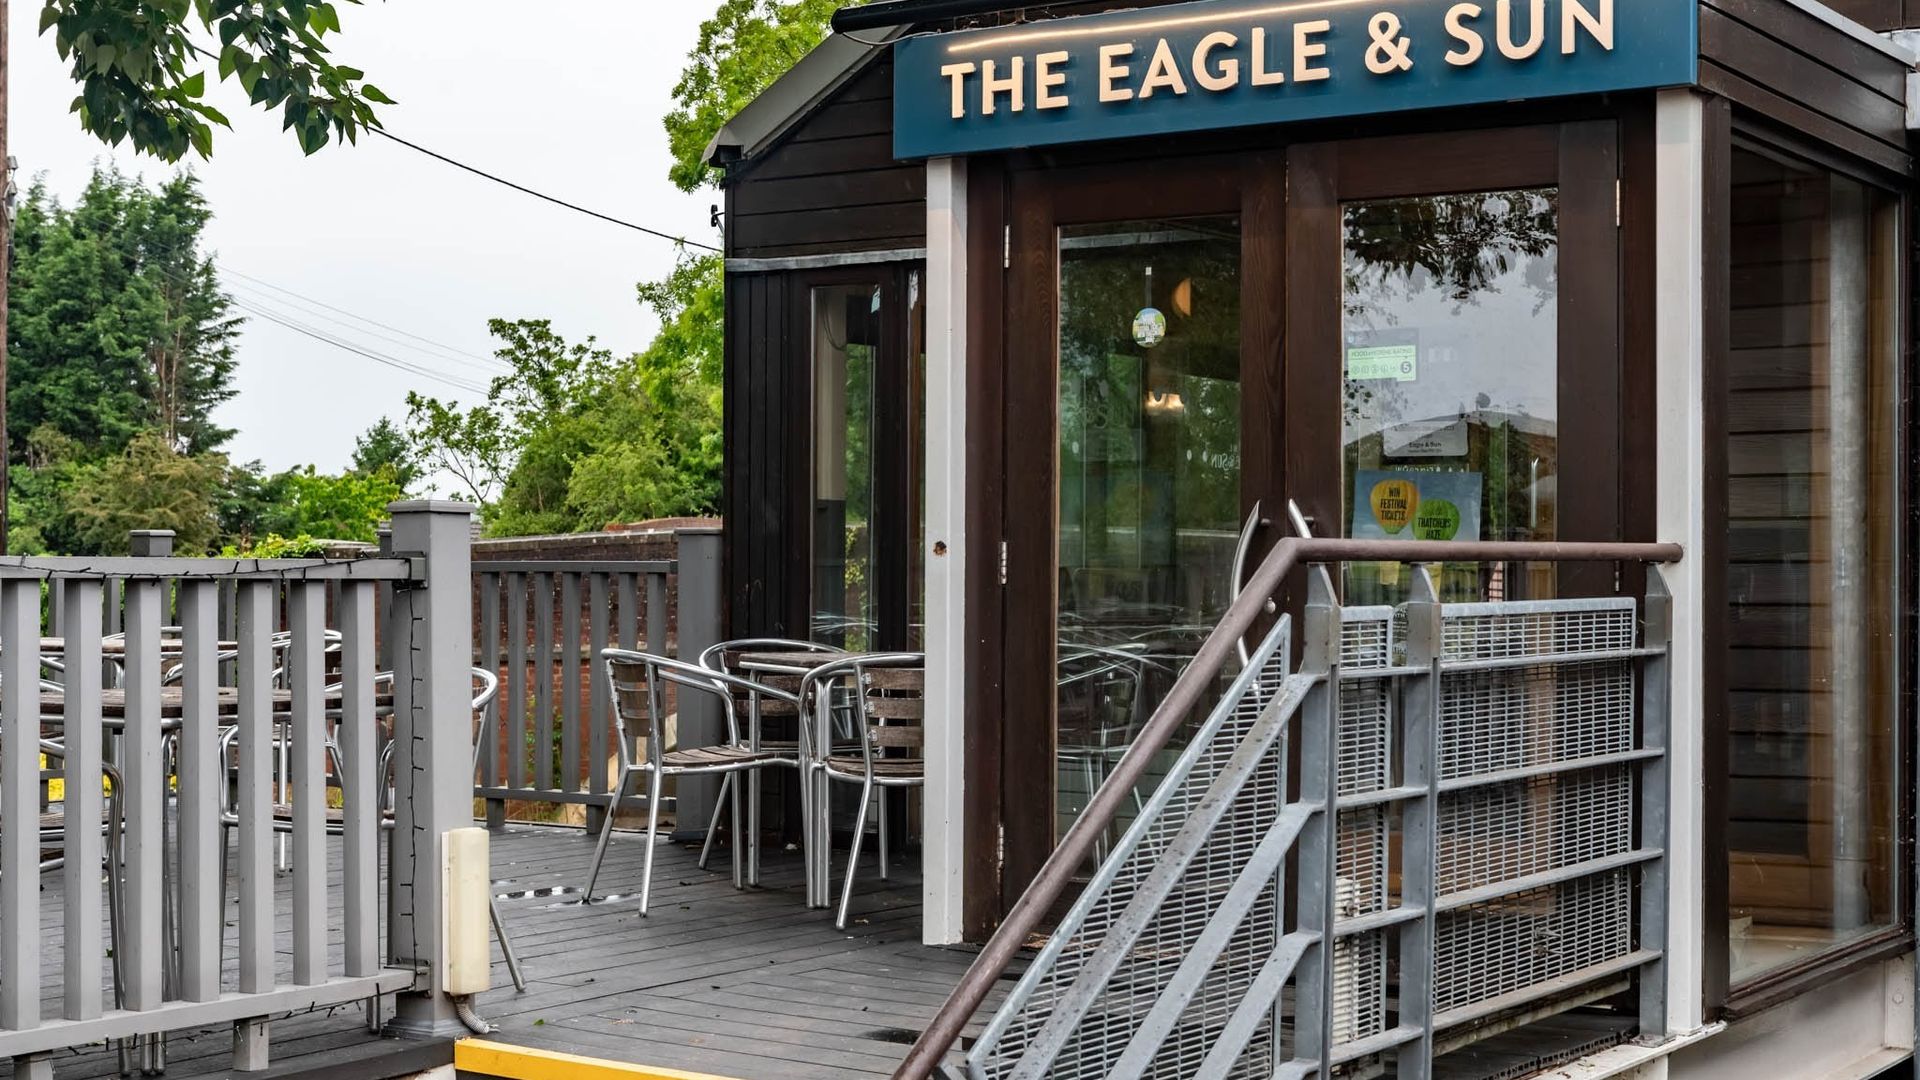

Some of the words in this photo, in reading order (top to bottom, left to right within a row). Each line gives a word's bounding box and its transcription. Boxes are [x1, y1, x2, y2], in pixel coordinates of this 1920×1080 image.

[940, 50, 1070, 119] THE
[1098, 18, 1331, 104] EAGLE
[1363, 10, 1413, 74] &
[1444, 0, 1615, 67] SUN
[1388, 487, 1401, 498] WIN
[1380, 498, 1408, 509] FESTIVAL
[1381, 510, 1406, 521] TICKETS
[1417, 517, 1451, 529] THATCHERS
[1425, 529, 1441, 540] HAZE
